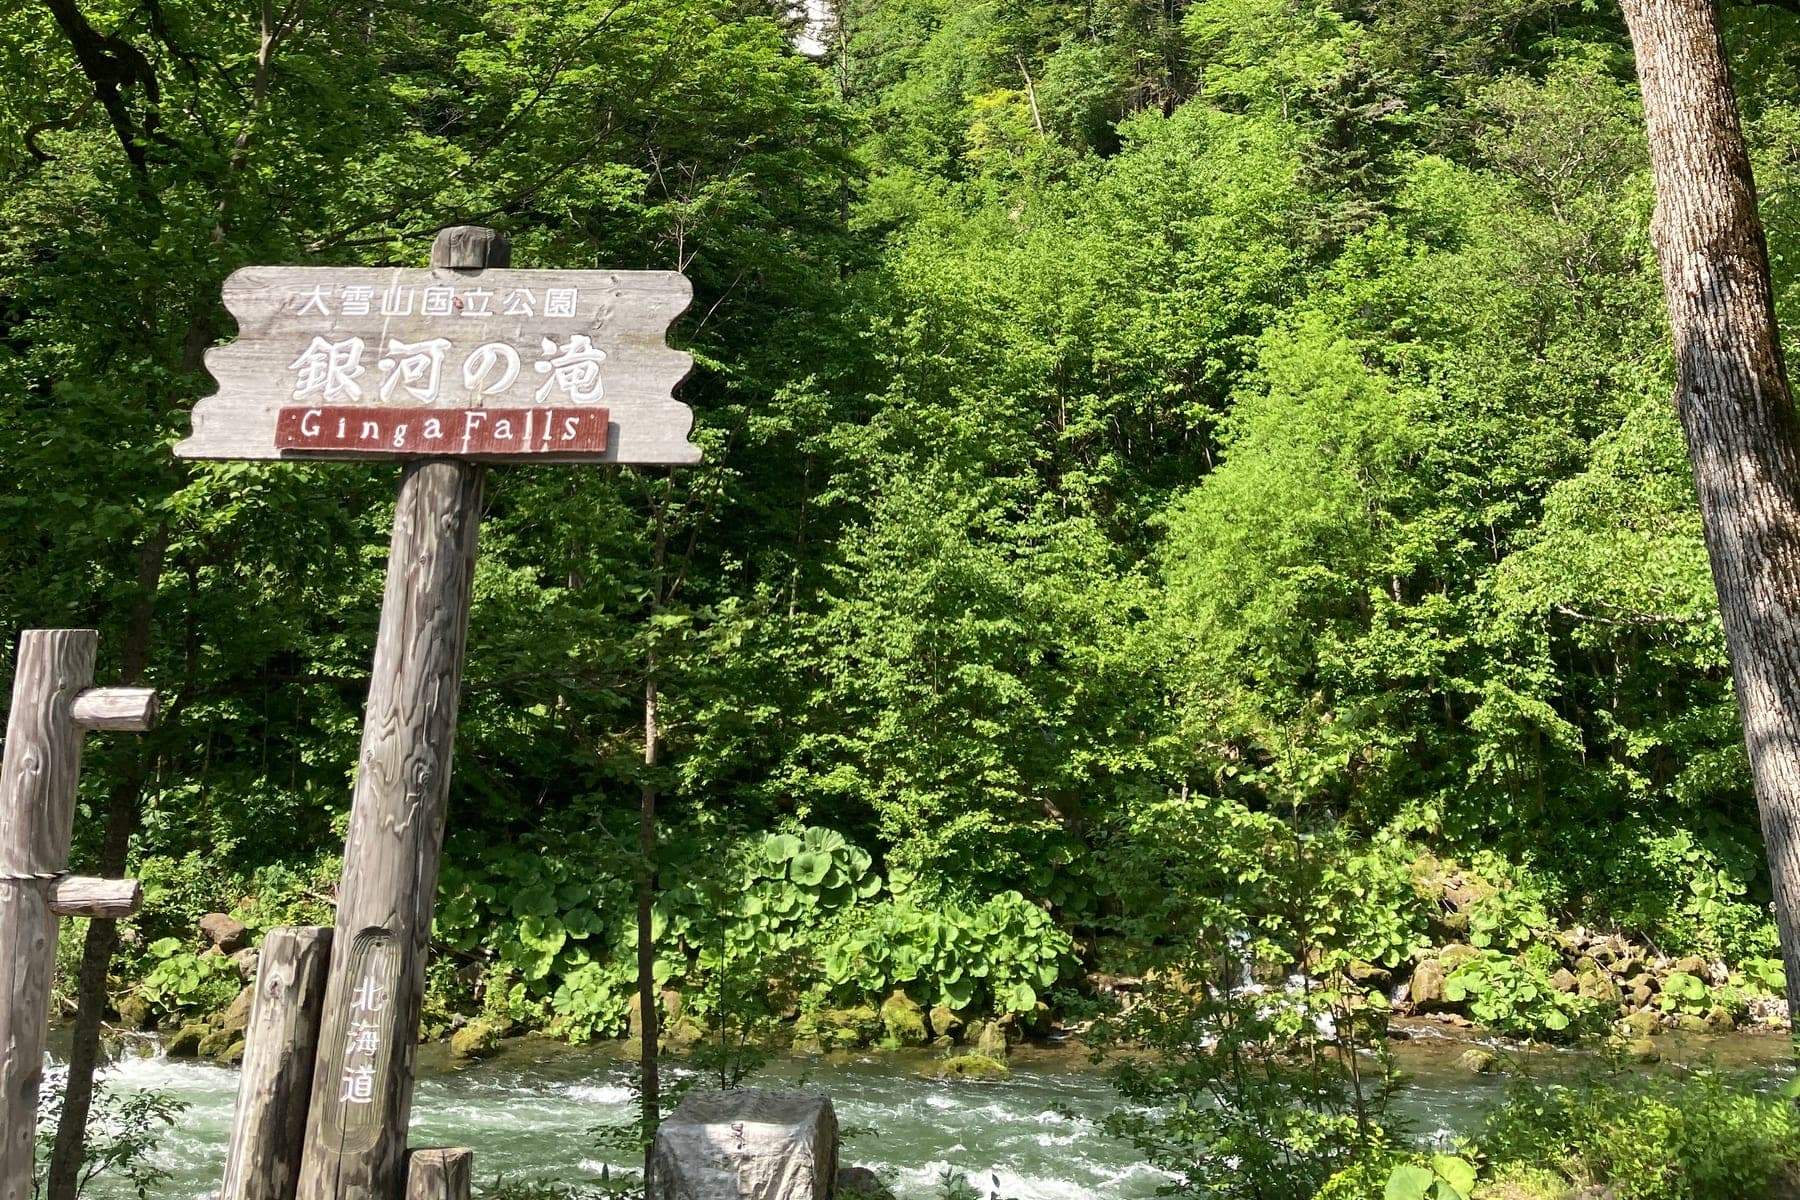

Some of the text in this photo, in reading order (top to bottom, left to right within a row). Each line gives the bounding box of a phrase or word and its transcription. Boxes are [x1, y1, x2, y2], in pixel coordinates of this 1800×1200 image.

[299, 285, 578, 318] 大雪山国立公園
[288, 335, 606, 404] 銀河の滝
[301, 409, 580, 446] Ginga Falls
[339, 976, 384, 1103] 北海道
